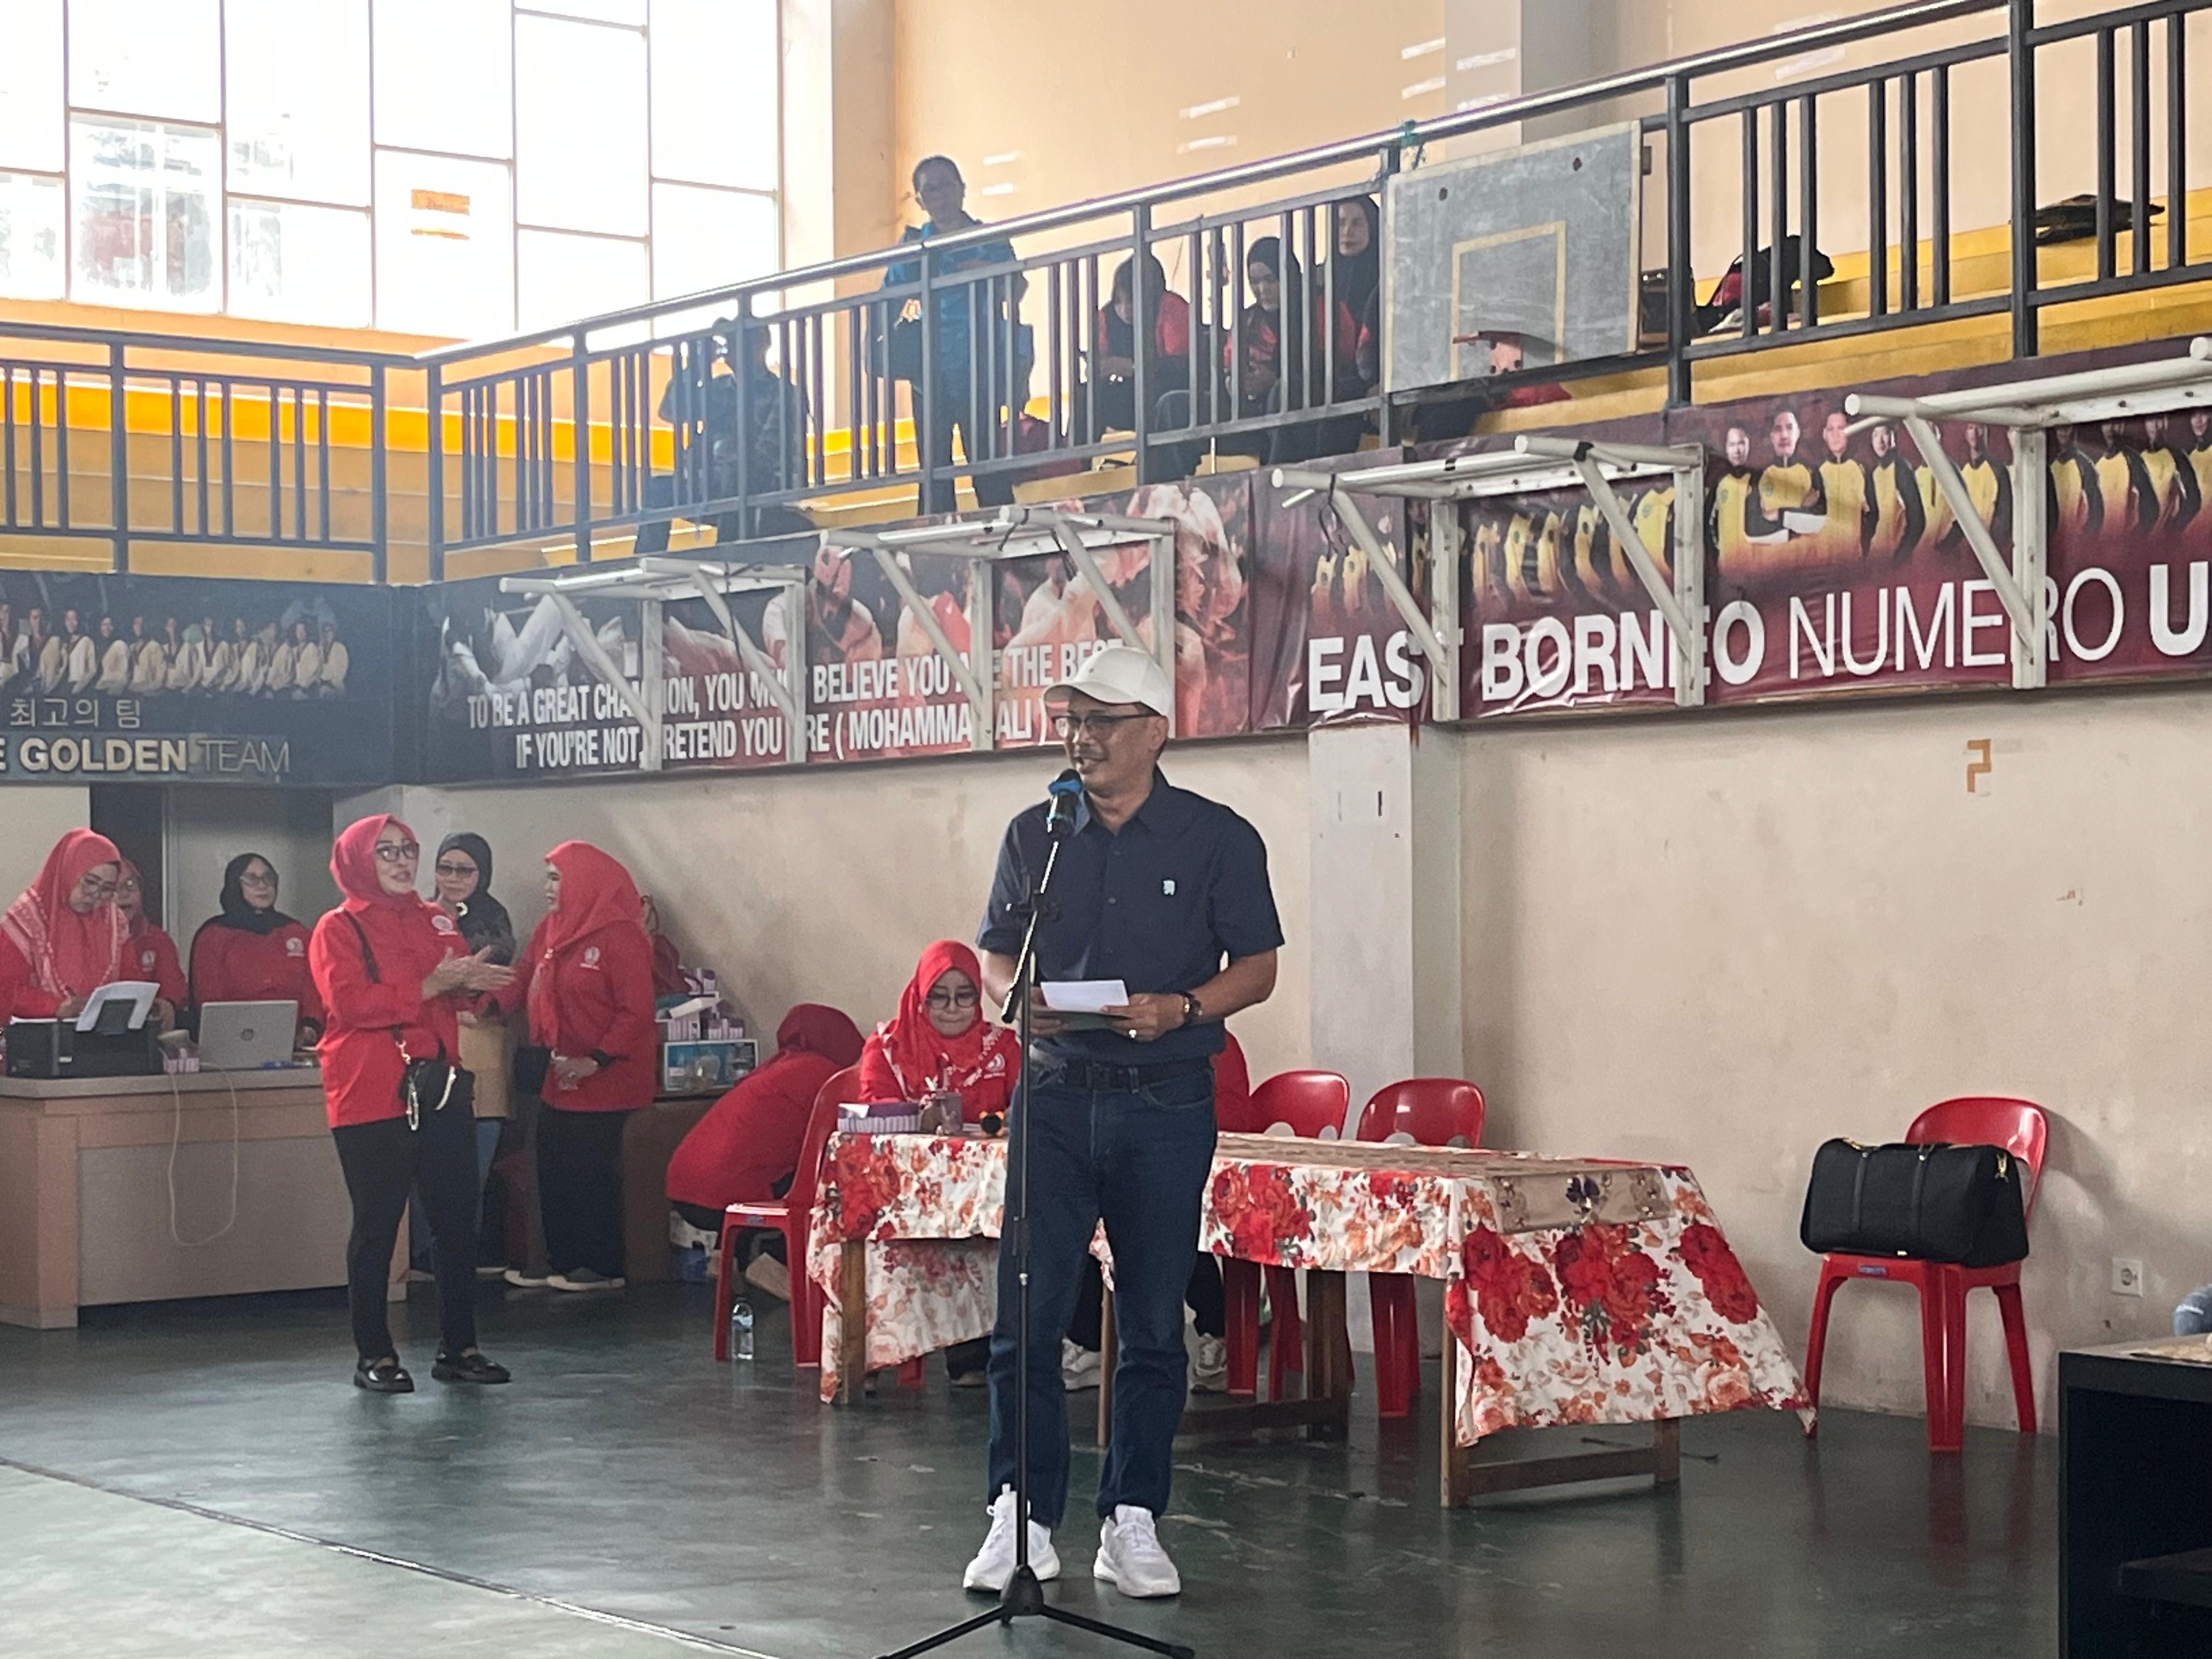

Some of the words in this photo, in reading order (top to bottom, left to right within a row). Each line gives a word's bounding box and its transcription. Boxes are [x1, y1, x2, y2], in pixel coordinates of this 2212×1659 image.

[467, 694, 488, 729] TO
[493, 692, 514, 727] BE
[517, 691, 530, 725] A
[533, 685, 590, 724] GREAT
[594, 676, 699, 720] CHAION,
[704, 672, 745, 711] YOU
[813, 658, 899, 703] BELIEVE
[905, 654, 950, 697] YOU
[1007, 645, 1053, 687] THE
[1308, 628, 1464, 712] EAS
[10, 697, 99, 727] 최고의
[116, 698, 140, 729] 팀
[516, 733, 532, 768] IF
[535, 729, 599, 768] YOU'RE
[662, 719, 737, 760] RETEND
[741, 716, 782, 756] YOU
[806, 713, 830, 752] RE
[849, 703, 973, 751] MOHAMMA
[995, 698, 1032, 740] ALI
[19, 737, 187, 772] GOLDEN
[198, 740, 290, 773] TEAM
